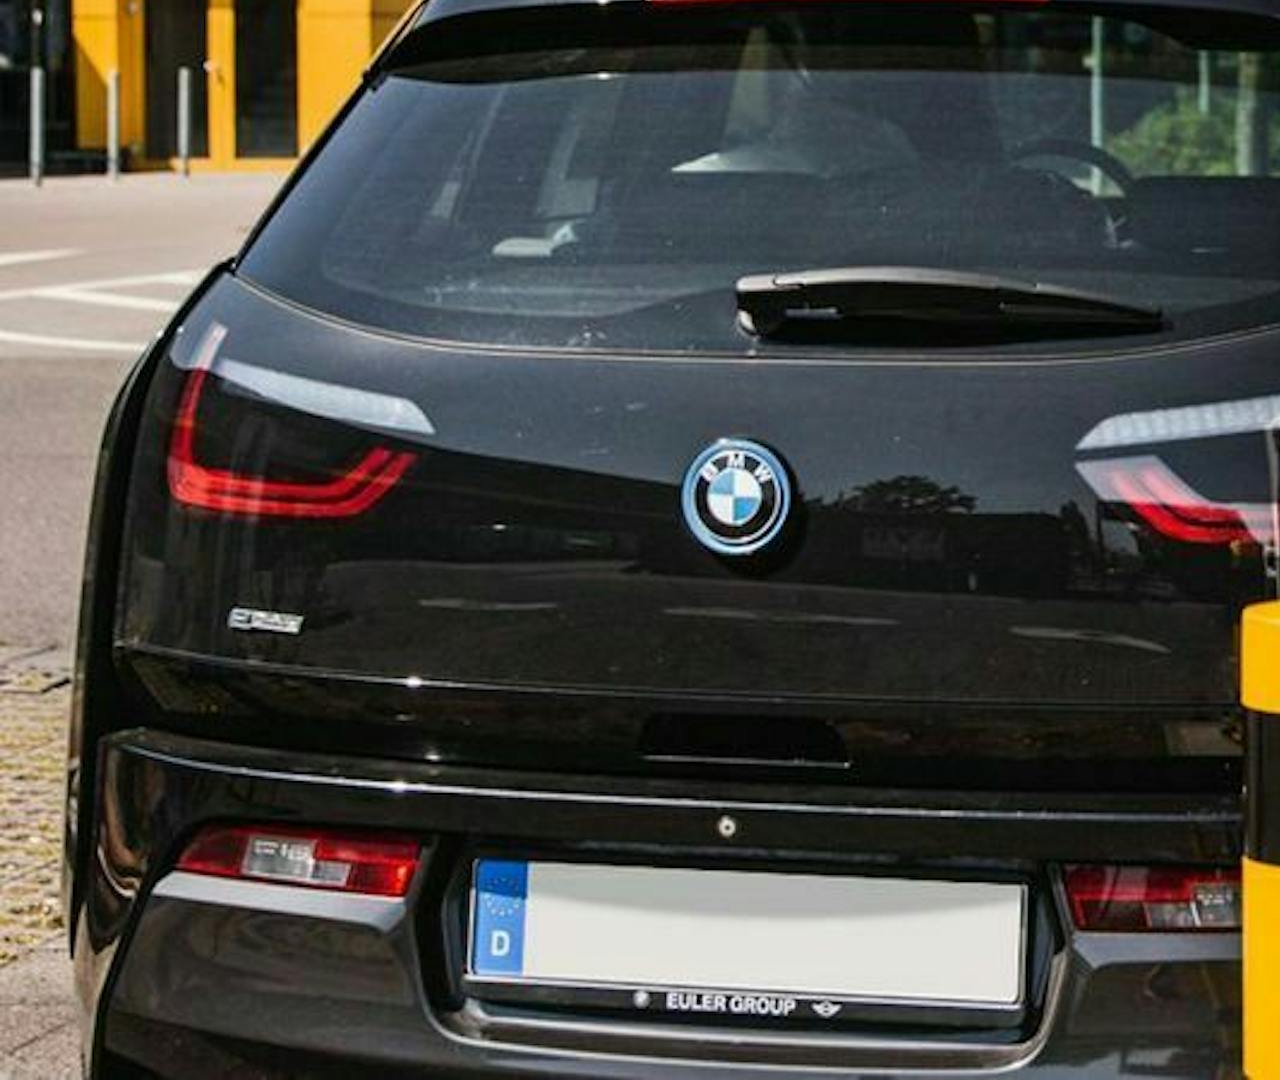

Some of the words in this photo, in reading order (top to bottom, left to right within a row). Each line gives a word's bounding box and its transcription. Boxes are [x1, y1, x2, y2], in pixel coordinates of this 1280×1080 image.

[490, 929, 510, 957] D
[665, 991, 727, 1013] EULER
[729, 994, 797, 1016] GROUP
